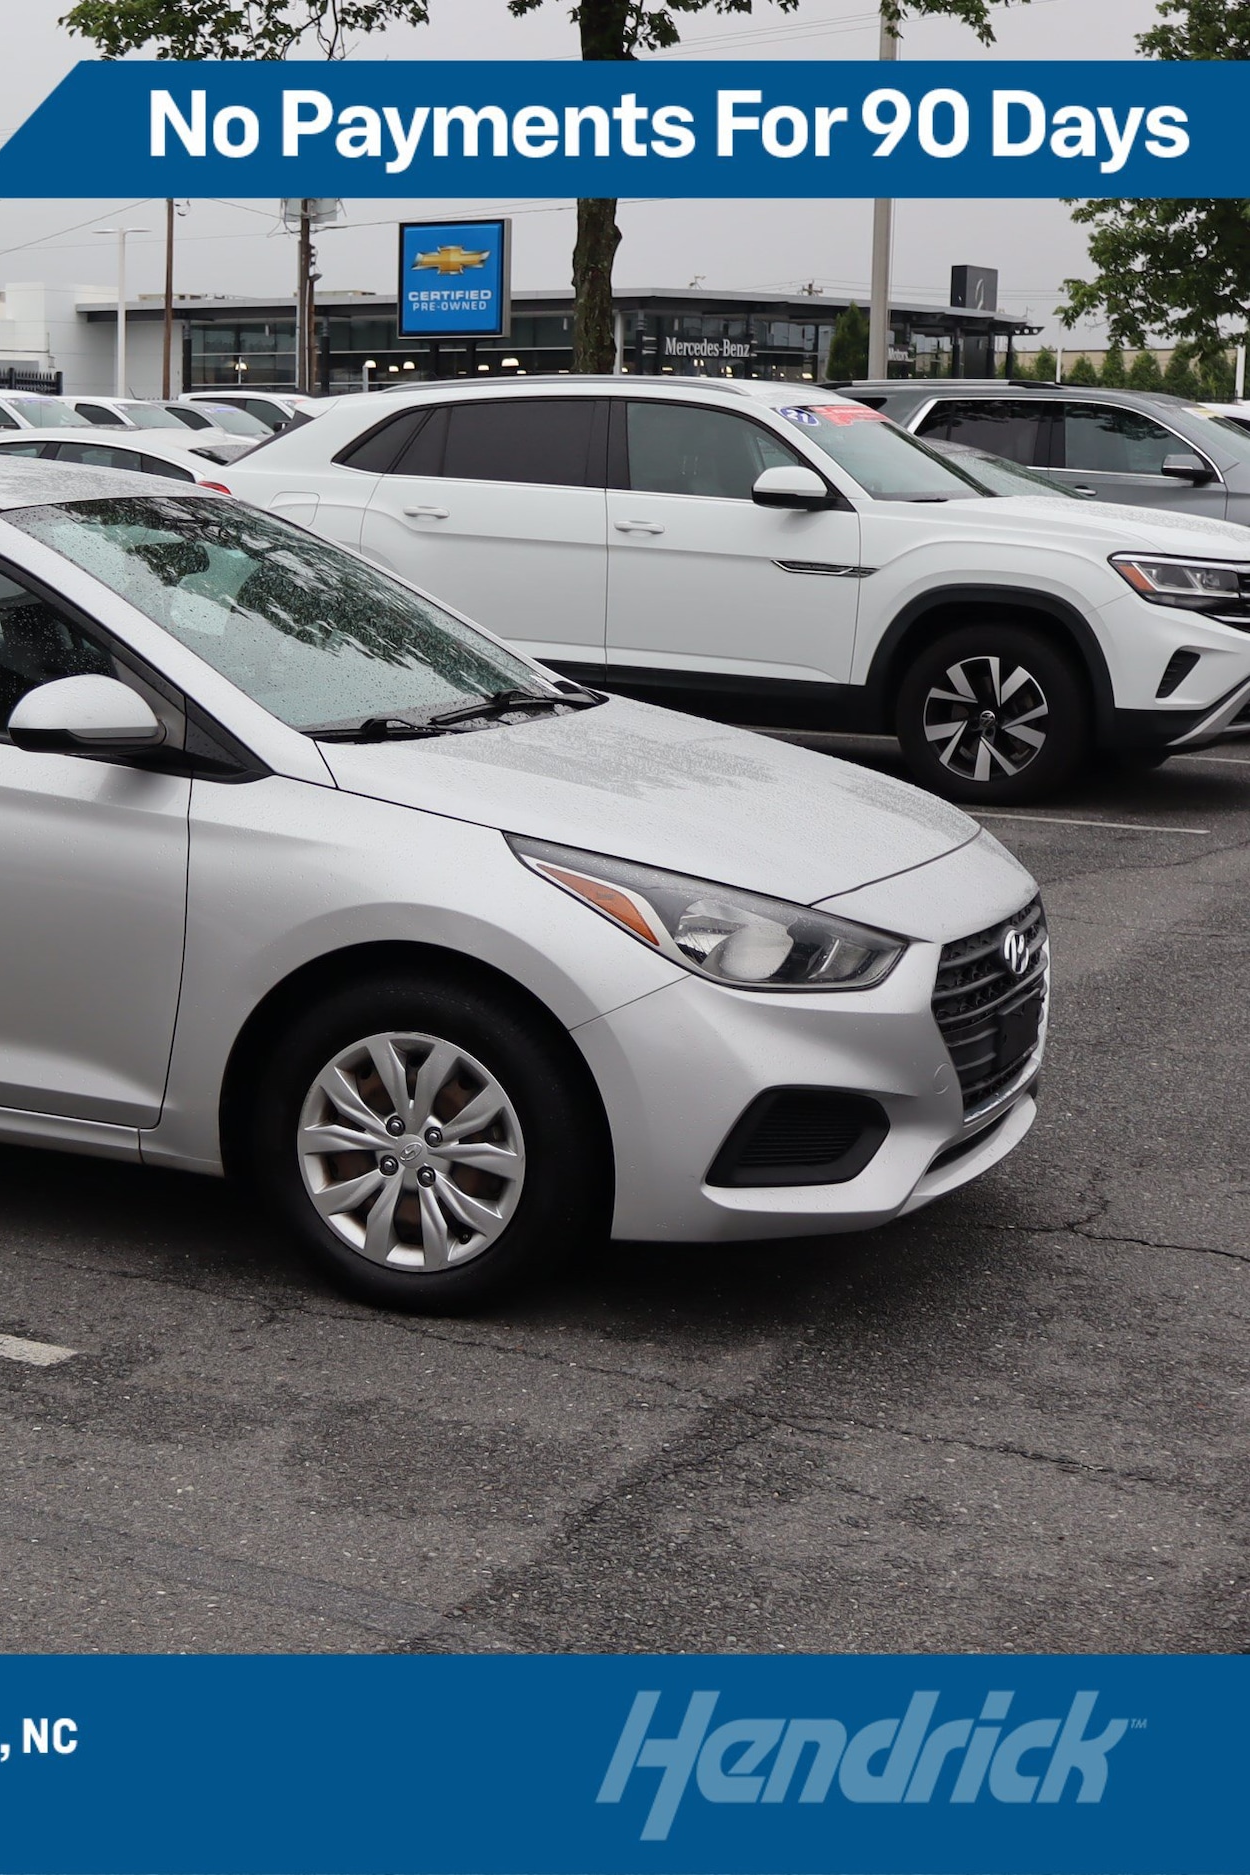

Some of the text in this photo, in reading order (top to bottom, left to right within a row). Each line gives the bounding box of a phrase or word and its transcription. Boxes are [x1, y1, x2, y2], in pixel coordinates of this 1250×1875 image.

[408, 290, 492, 301] CERTIFIED
[412, 301, 487, 311] PRE-OWNED
[665, 336, 750, 357] Mercedes-Benz
